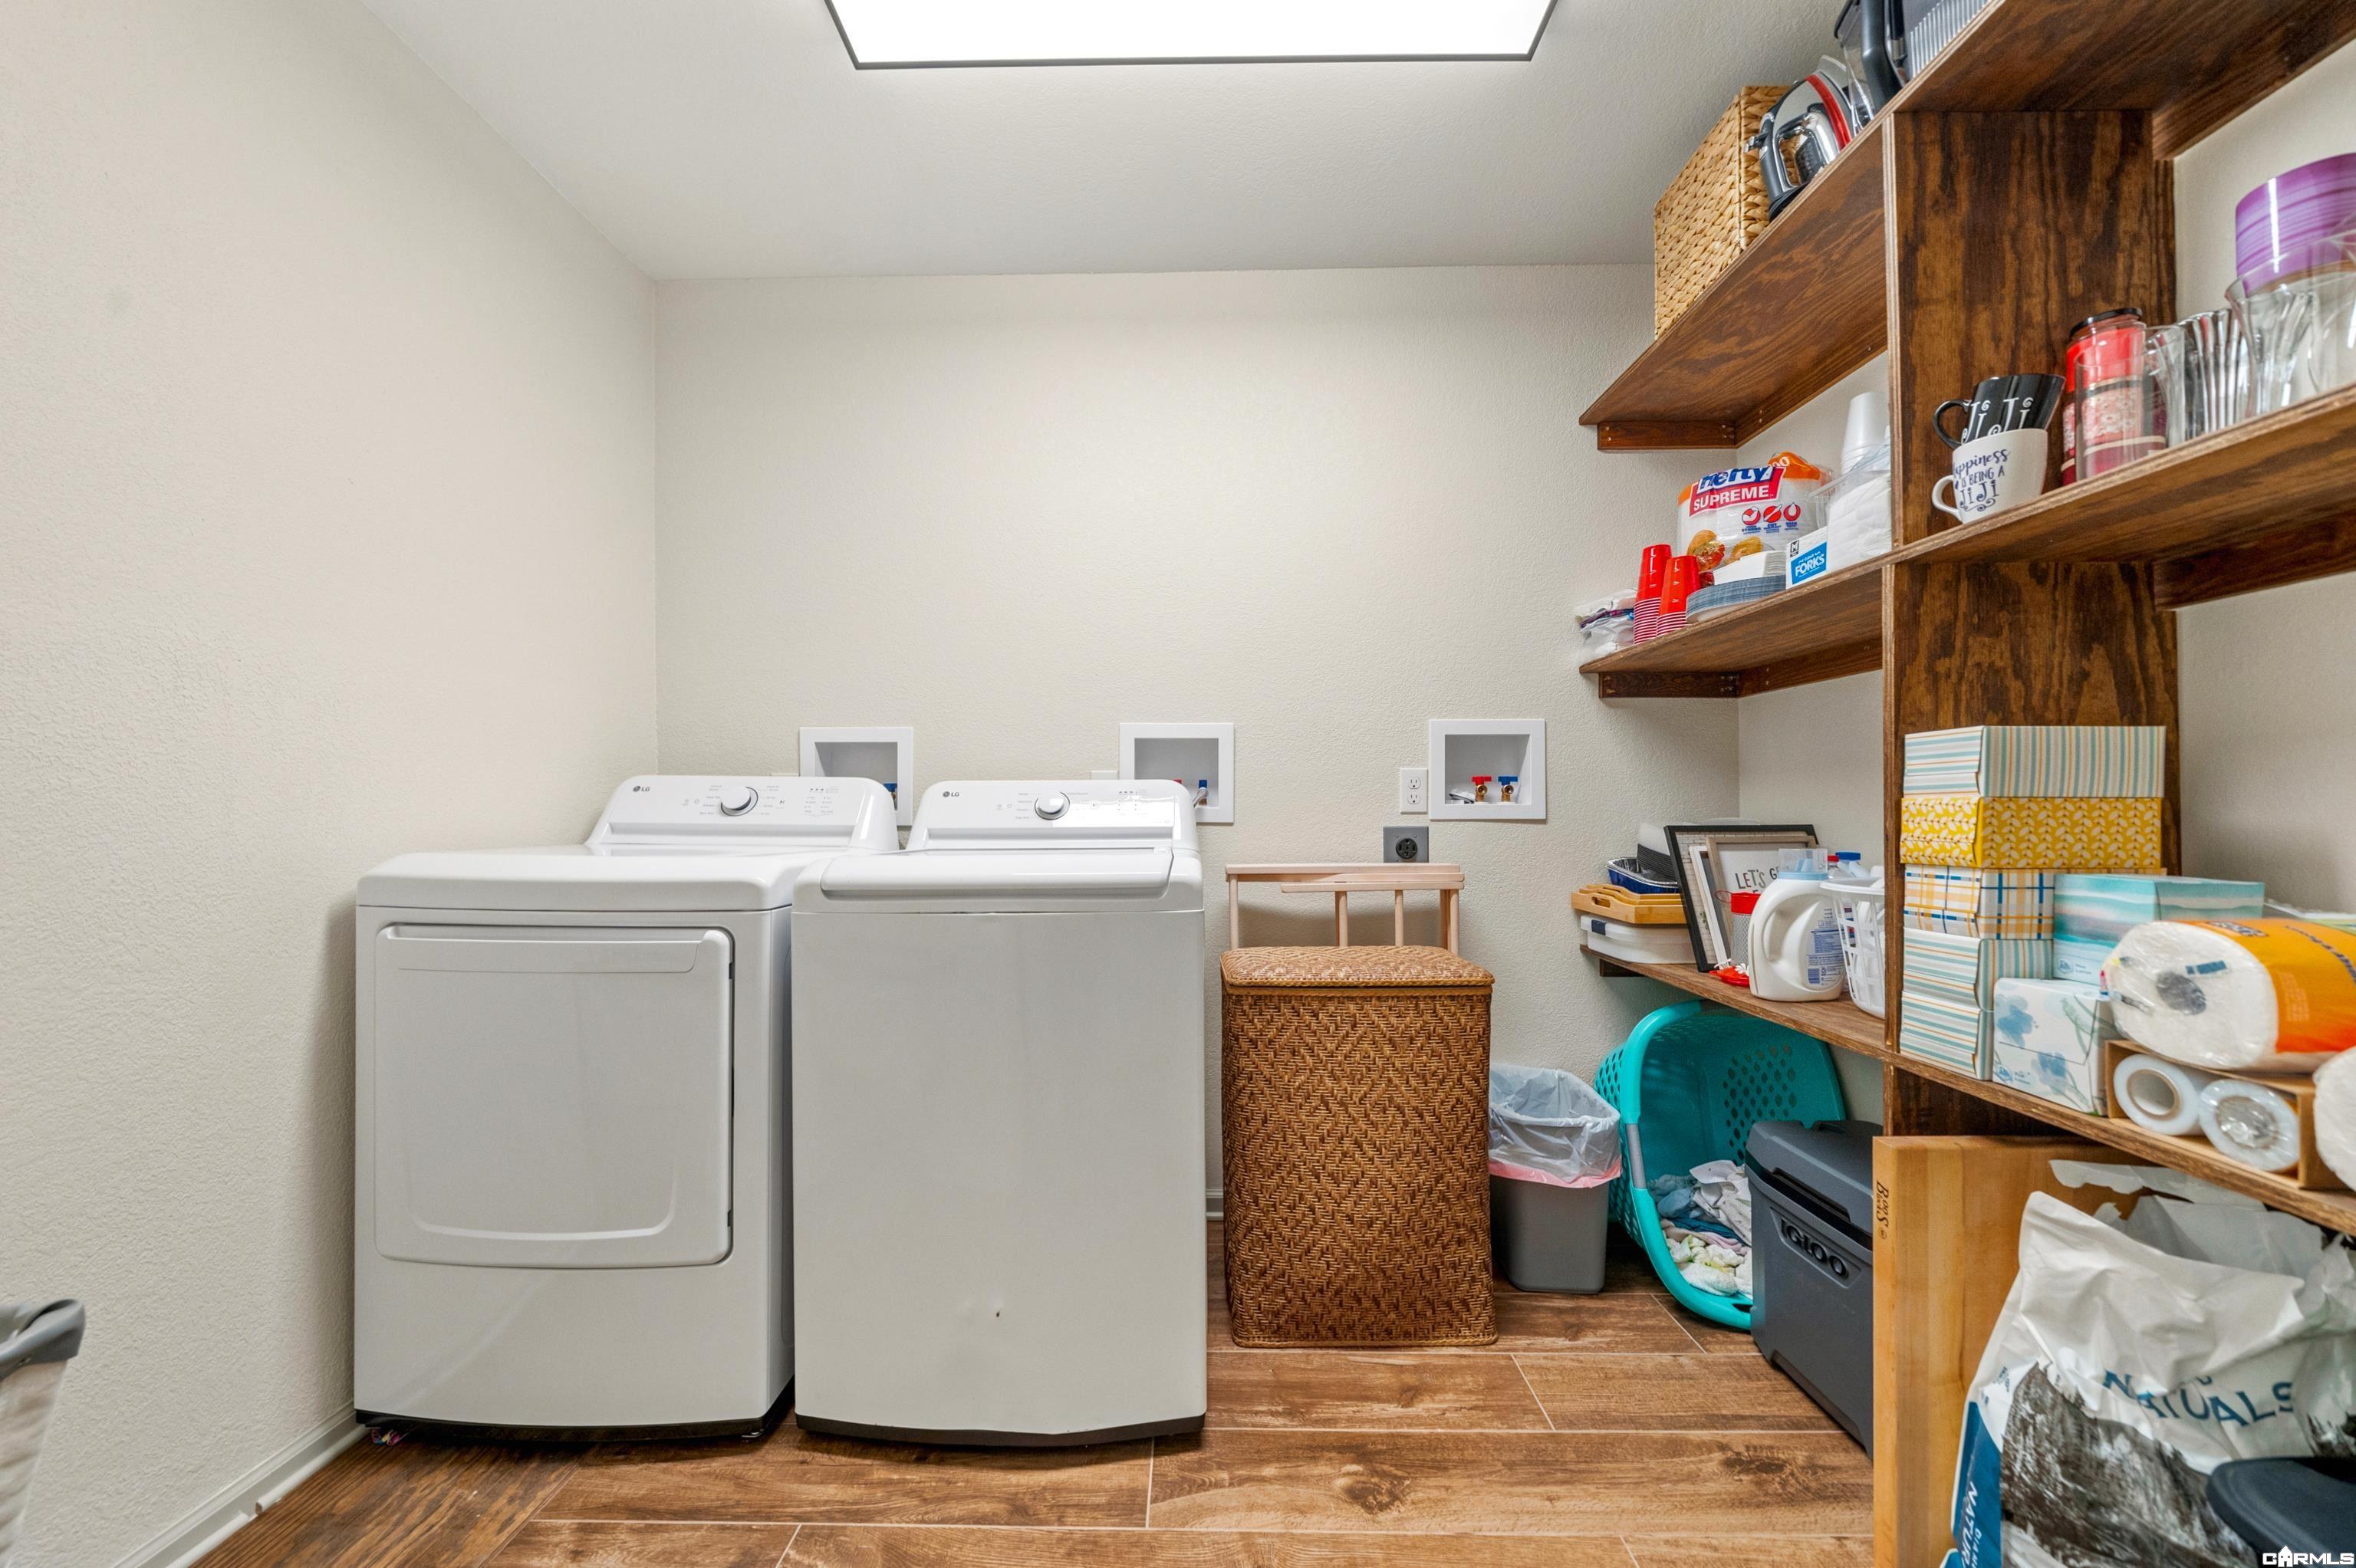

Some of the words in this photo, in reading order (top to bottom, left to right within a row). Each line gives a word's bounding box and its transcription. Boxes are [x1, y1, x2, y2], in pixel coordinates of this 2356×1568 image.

[1953, 449, 2010, 478] appiness
[1969, 467, 1995, 485] BEING
[1998, 465, 2006, 478] A
[1693, 485, 1769, 511] SUPREME
[1795, 554, 1825, 577] FORKS
[1735, 869, 1766, 889] LET'S
[1780, 1218, 1849, 1279] IGLOO
